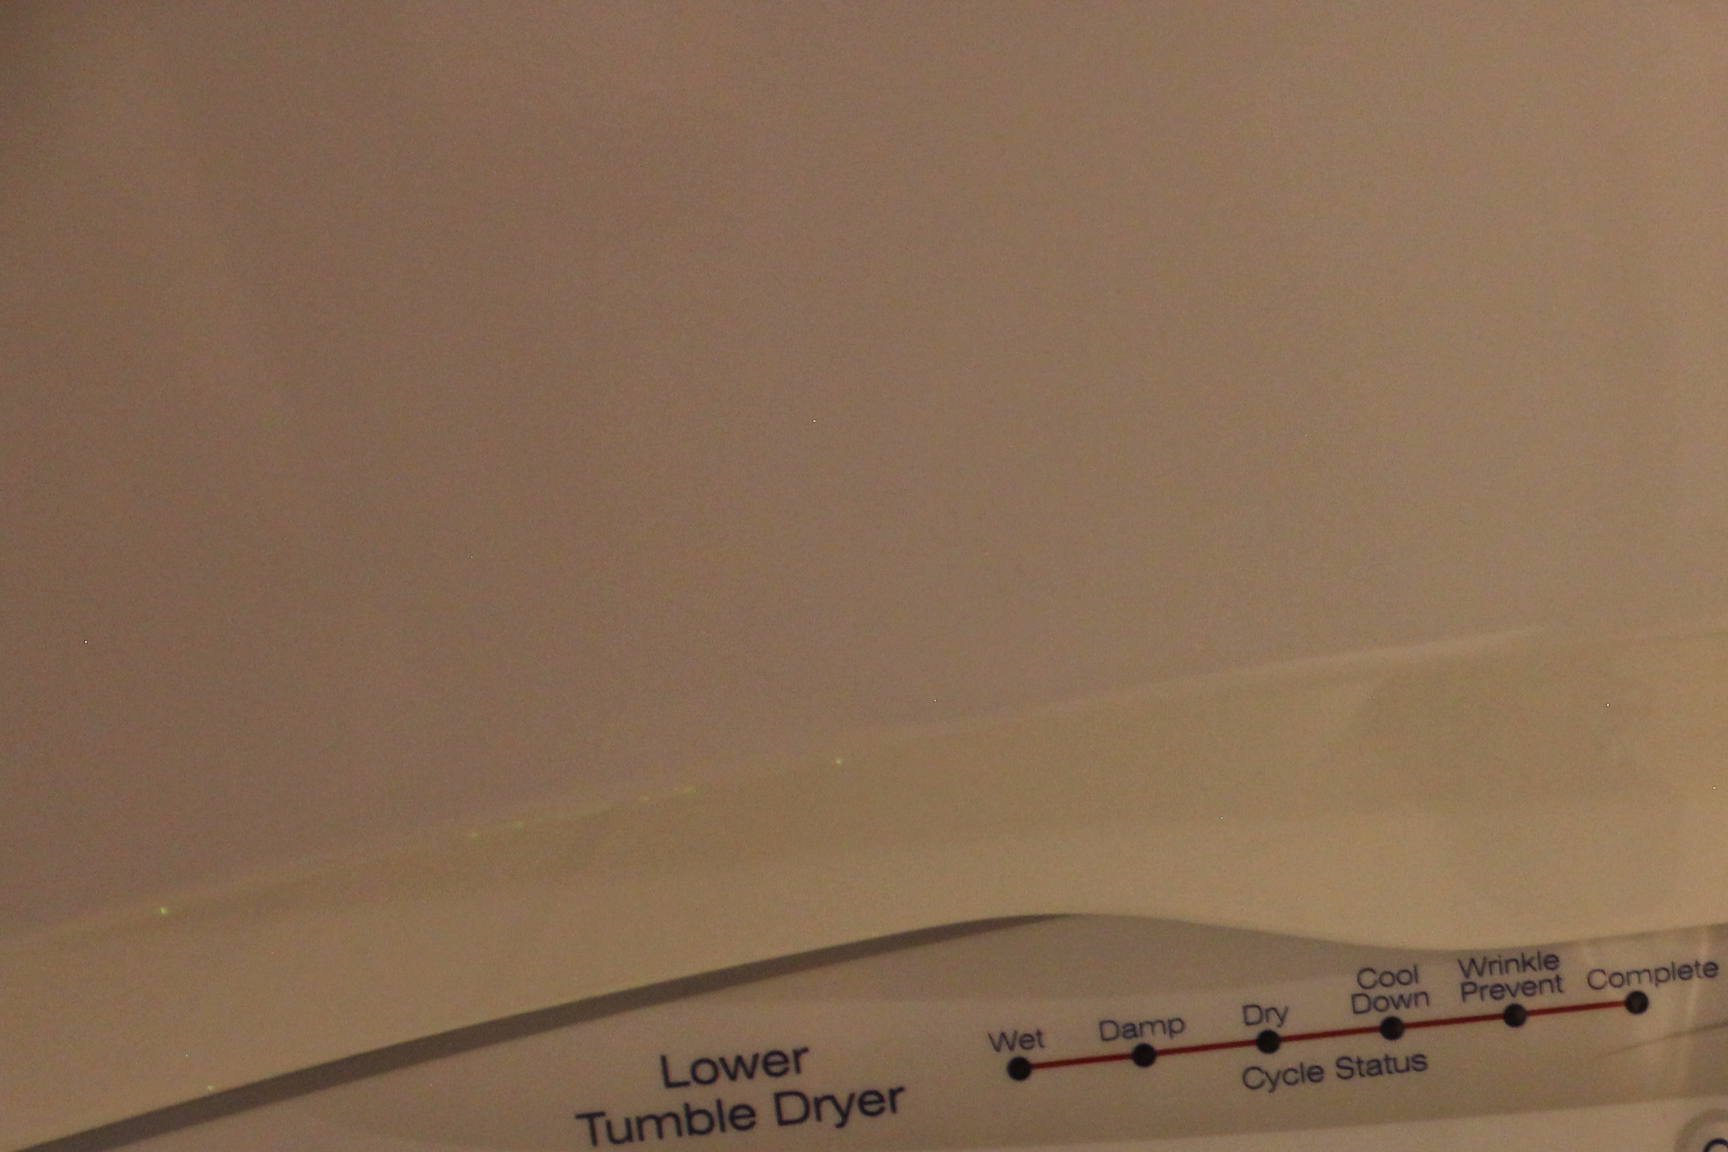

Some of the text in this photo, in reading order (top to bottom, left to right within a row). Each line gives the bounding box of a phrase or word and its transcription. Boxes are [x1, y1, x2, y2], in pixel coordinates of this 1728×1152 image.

[1355, 963, 1421, 991] Cool
[1457, 950, 1561, 980] Wrinkle
[1586, 957, 1720, 993] Complete
[1350, 987, 1430, 1016] Down
[1458, 974, 1566, 1003] Prevent
[1099, 1014, 1186, 1044] Damp
[1242, 1003, 1291, 1030] Dry
[987, 1029, 1046, 1054] Wet
[659, 1045, 810, 1090] Lower
[1241, 1050, 1429, 1093] Cycle Status
[575, 1085, 906, 1148] Tumble Dryer
